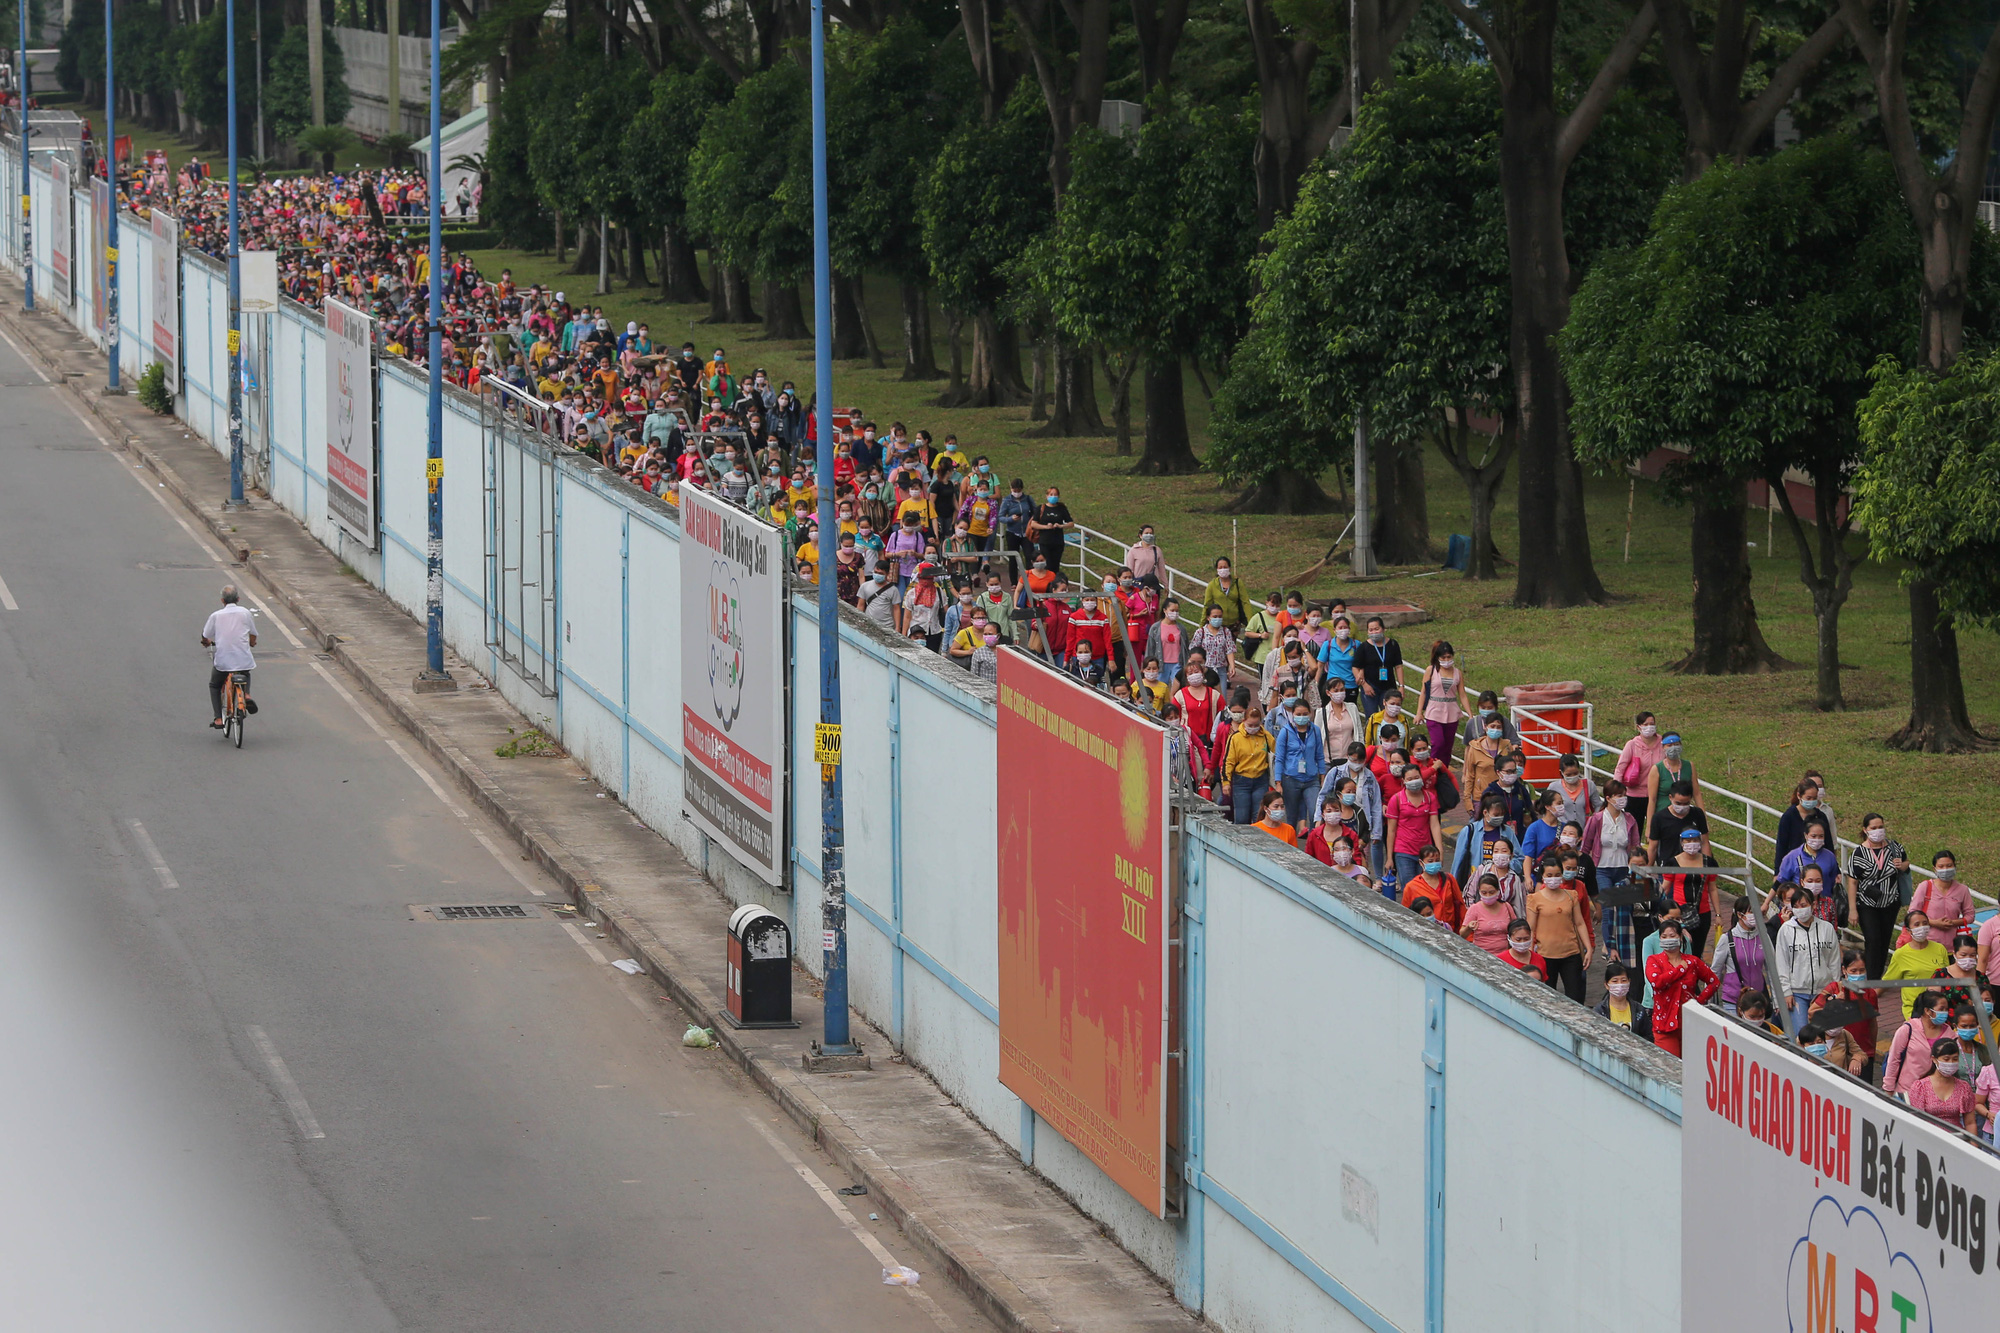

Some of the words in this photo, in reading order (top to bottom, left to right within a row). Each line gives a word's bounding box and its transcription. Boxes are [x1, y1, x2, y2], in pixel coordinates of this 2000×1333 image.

[722, 515, 734, 560] Bất
[736, 524, 752, 579] Động
[754, 530, 767, 575] Sản
[822, 732, 840, 752] 900
[1115, 853, 1133, 889] ĐẠI
[1136, 866, 1153, 902] HỘI
[1122, 892, 1146, 944] XIII
[1138, 1153, 1156, 1182] QUỐC
[1706, 1026, 1744, 1128] SÀN
[1749, 1060, 1794, 1157] GIAO
[1800, 1086, 1852, 1188] DỊCH
[1861, 1117, 1906, 1216] Bất
[1915, 1148, 1986, 1275] Động
